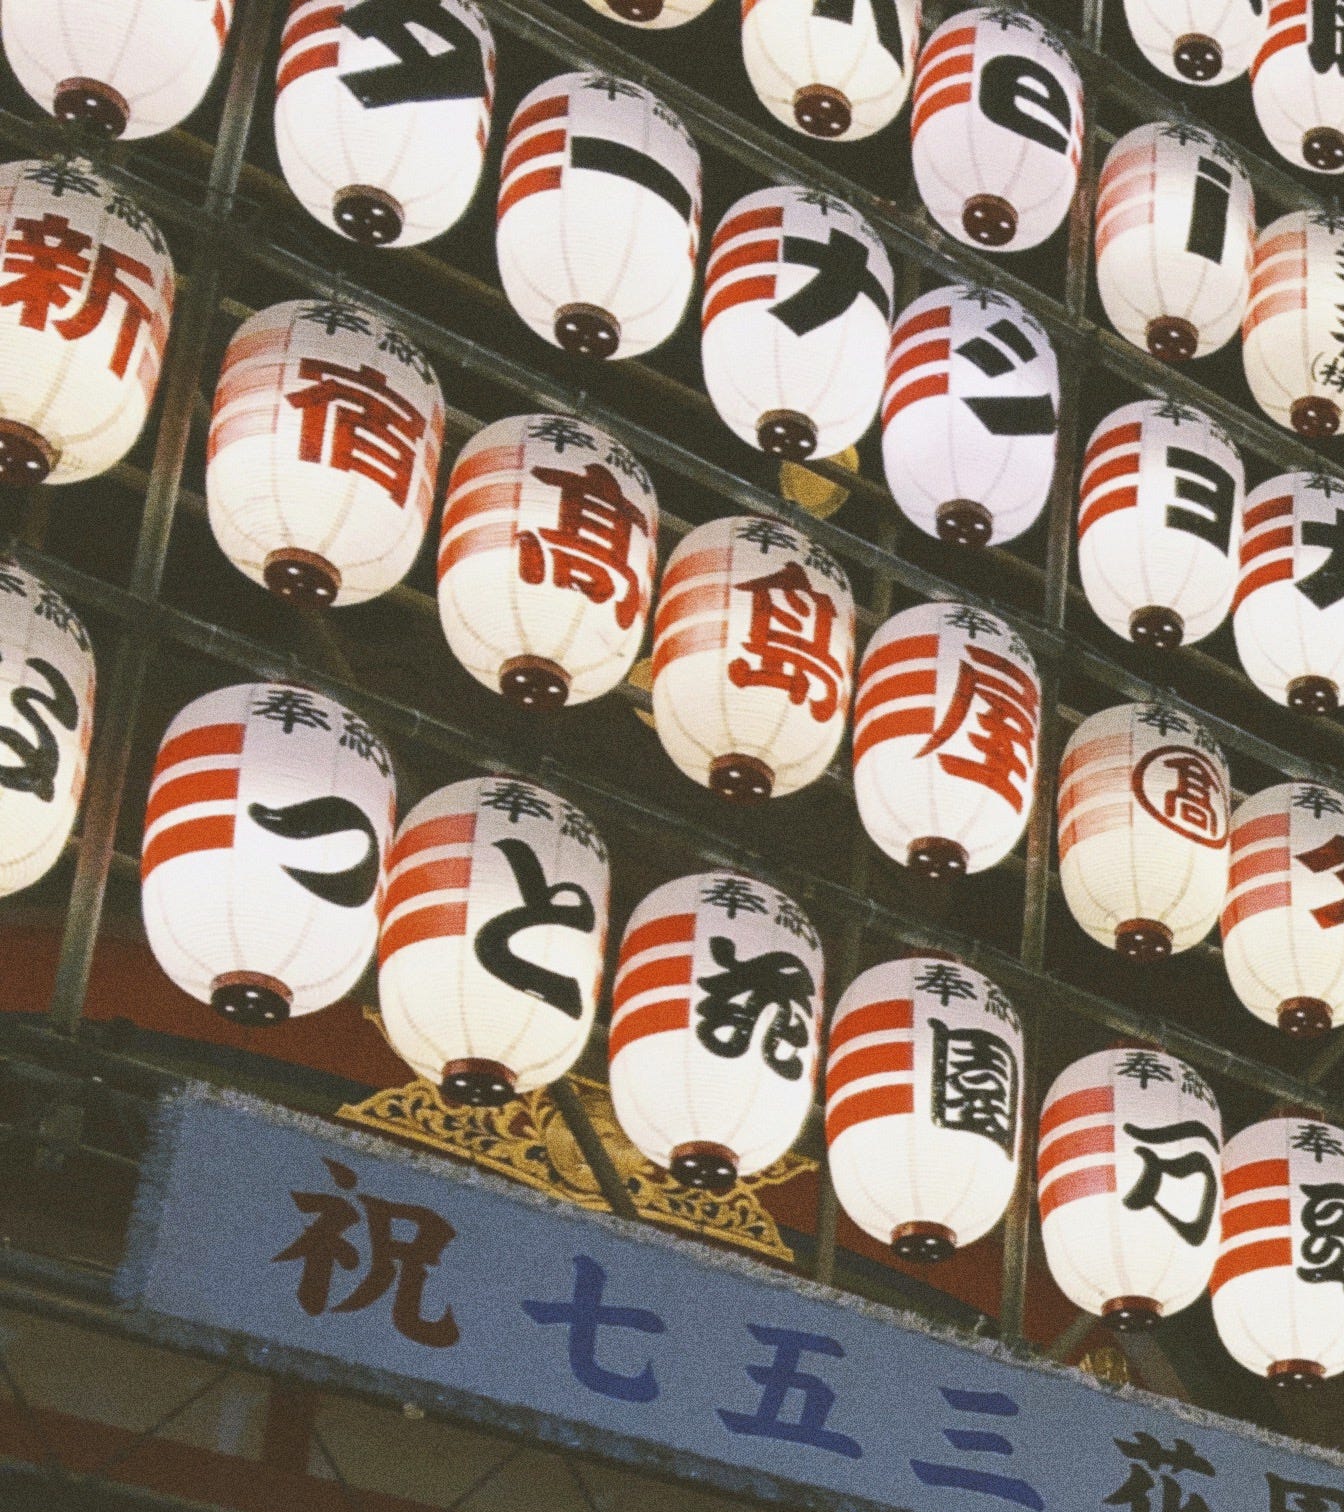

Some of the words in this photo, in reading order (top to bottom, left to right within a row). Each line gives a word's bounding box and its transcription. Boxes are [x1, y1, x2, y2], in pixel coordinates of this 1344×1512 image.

[0, 213, 153, 377] 新
[287, 358, 425, 508] 宿
[252, 688, 389, 779] 奉納
[915, 645, 1039, 814] 屋
[247, 796, 379, 909] つ
[481, 780, 608, 863] 奉納
[474, 838, 595, 1019] と
[702, 876, 822, 951] 奉納
[915, 963, 1021, 1037] 奉納
[272, 1156, 460, 1347] 祝
